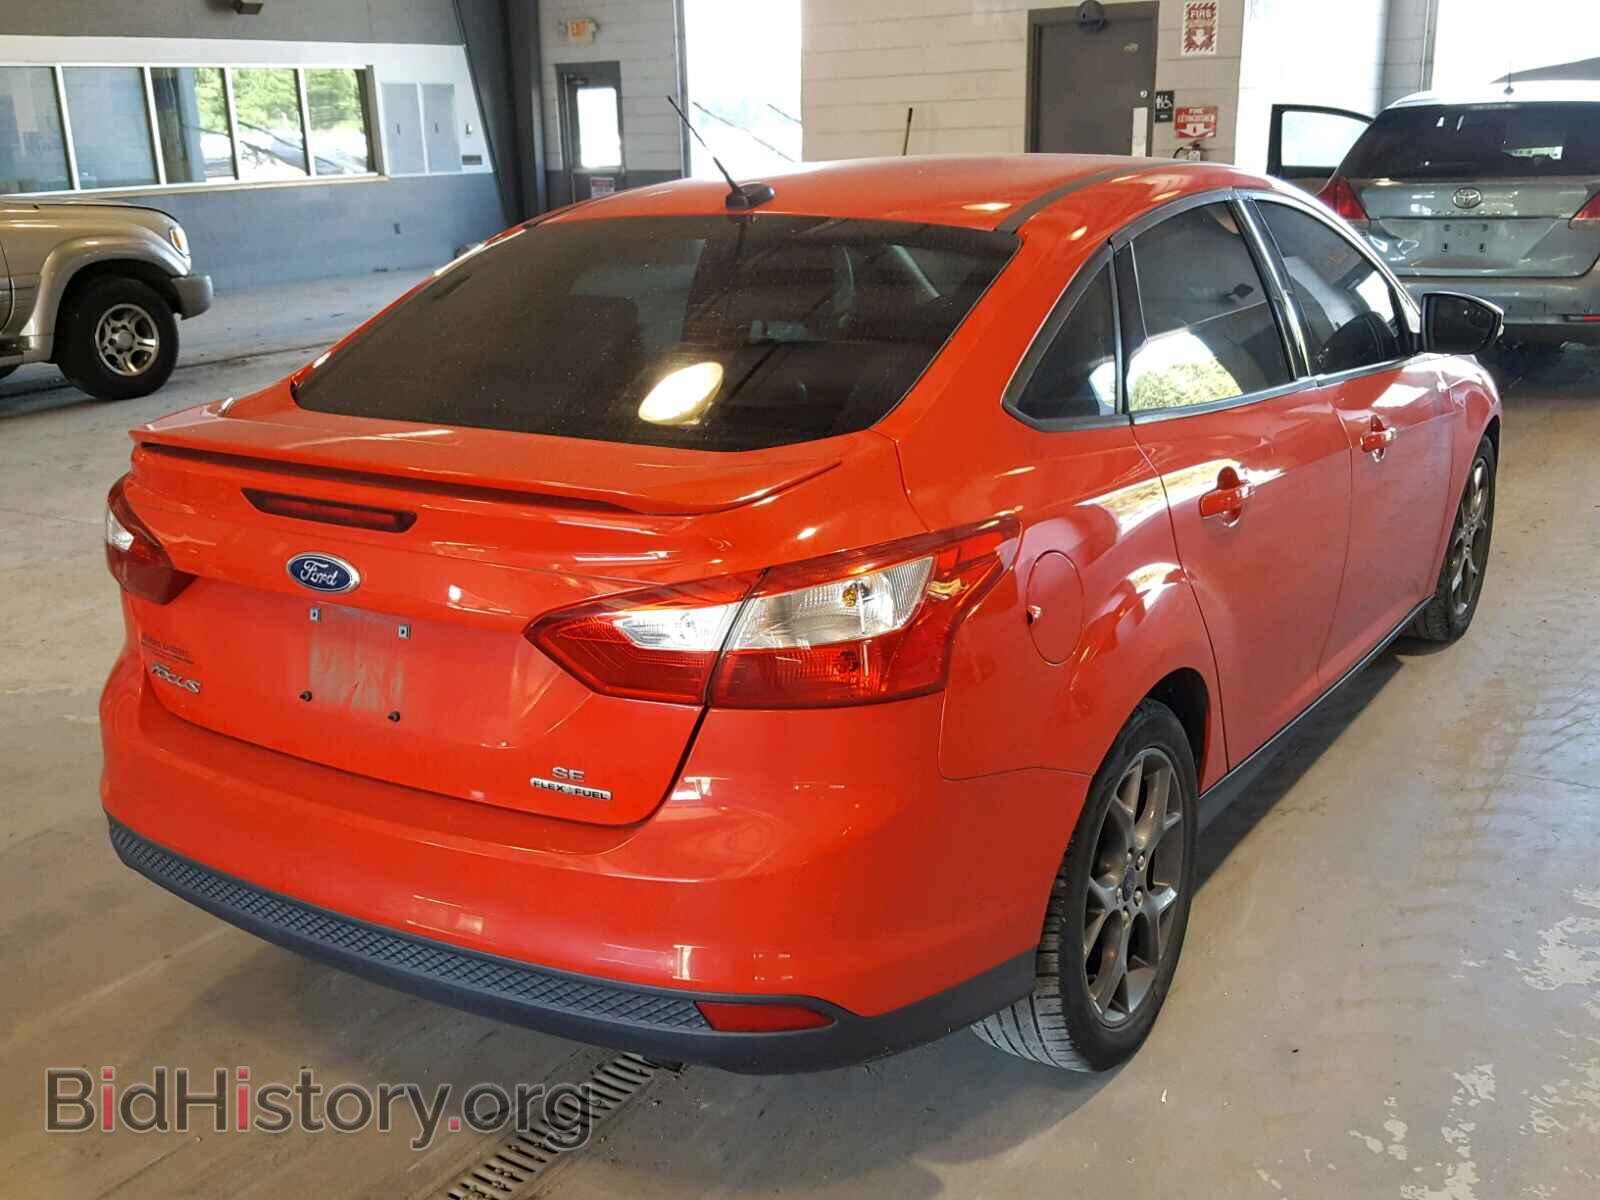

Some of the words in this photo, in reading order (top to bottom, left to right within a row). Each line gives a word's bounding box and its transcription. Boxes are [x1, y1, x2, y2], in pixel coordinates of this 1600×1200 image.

[1190, 9, 1212, 18] FIRE
[300, 560, 338, 586] Ford
[552, 766, 584, 782] SE
[533, 779, 564, 792] FLEX
[574, 787, 610, 800] FUEL
